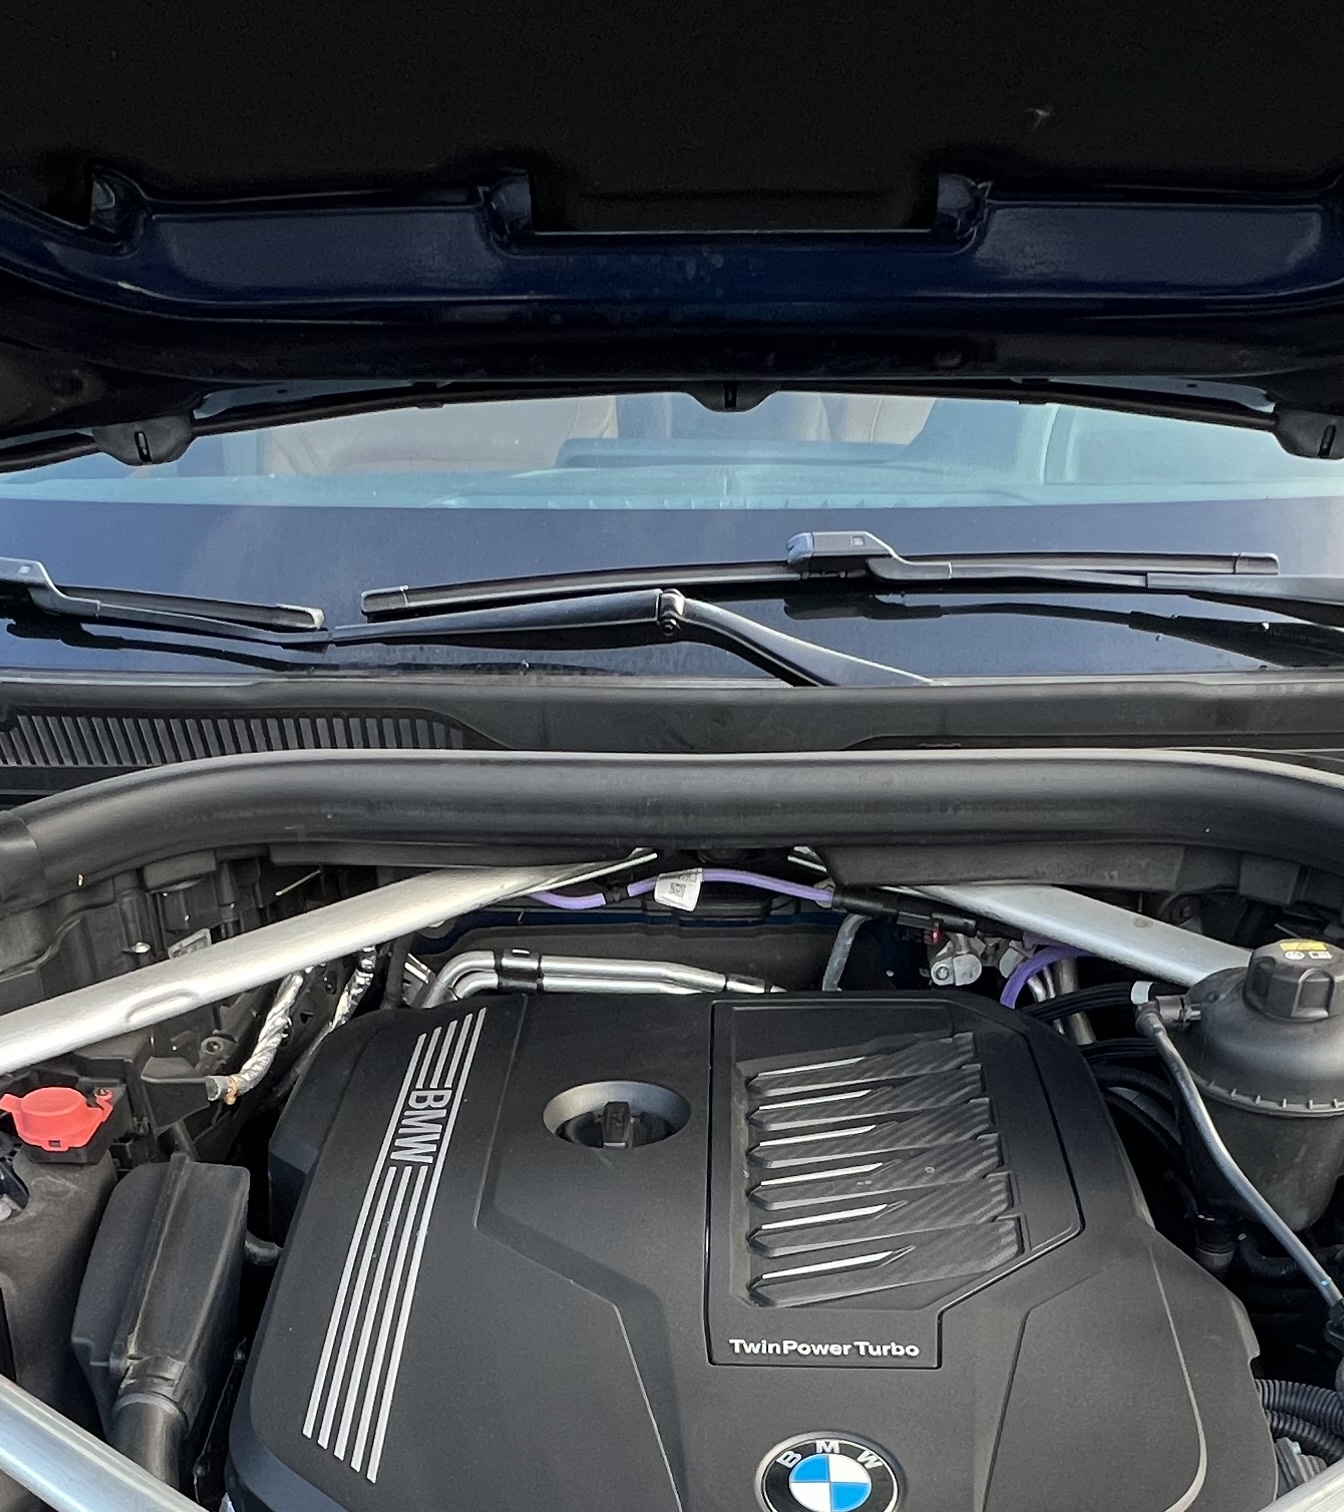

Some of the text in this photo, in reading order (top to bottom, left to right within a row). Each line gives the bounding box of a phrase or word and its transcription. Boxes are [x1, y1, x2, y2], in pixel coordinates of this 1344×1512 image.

[390, 1089, 453, 1164] BMW
[853, 1341, 920, 1357] Turbo
[776, 1439, 884, 1469] BMW
